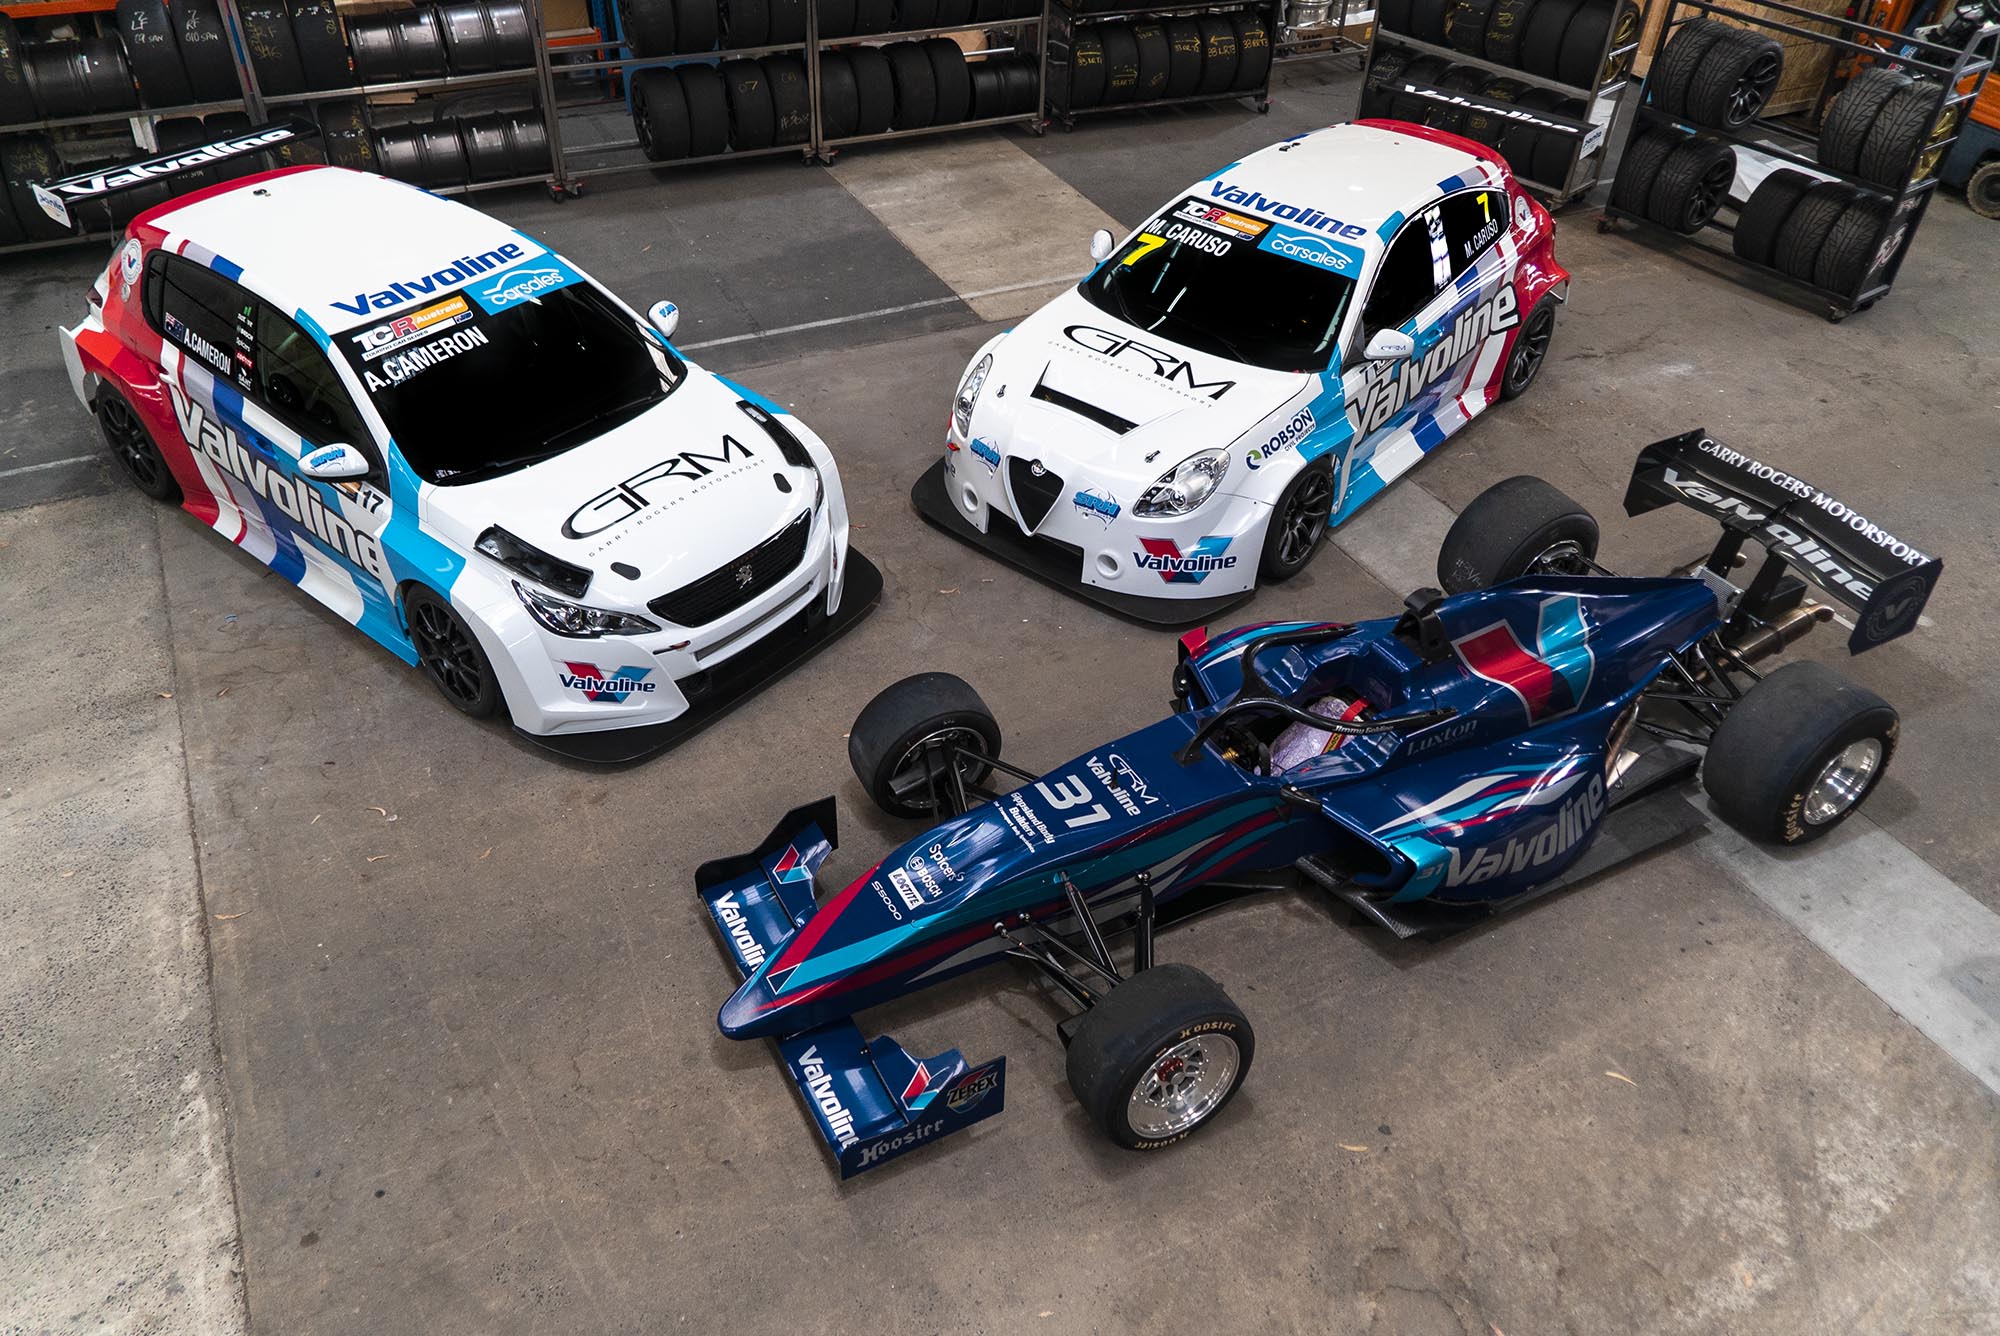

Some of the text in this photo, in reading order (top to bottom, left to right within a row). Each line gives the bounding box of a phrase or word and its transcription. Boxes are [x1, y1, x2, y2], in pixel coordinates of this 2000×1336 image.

[60, 128, 295, 194] Valvoline
[1210, 180, 1368, 241] Valvoline
[1476, 192, 1490, 223] 7
[1123, 232, 1168, 266] 7
[1144, 218, 1232, 257] M. CARUSO
[1270, 237, 1348, 271] carsales
[1473, 218, 1499, 252] CARUSO
[329, 242, 525, 317] Valvoline
[490, 270, 565, 306] carsales
[182, 327, 232, 377] A.CAMERON
[363, 325, 491, 393] A.CAMERON
[1063, 325, 1237, 400] GRM
[1340, 279, 1520, 448] Valvoline
[1260, 409, 1315, 460] ROBSON
[168, 398, 386, 583] Valvoline
[362, 488, 385, 515] 17
[561, 434, 755, 540] GRM
[1698, 438, 1932, 568] GARRY ROGERS MOTORSPORT
[1663, 466, 1874, 602] Valvoline
[1132, 551, 1238, 572] Valvoline
[558, 673, 656, 693] Valvoline
[1008, 806, 1036, 837] Builders
[1034, 774, 1111, 828] 31
[1036, 823, 1056, 845] Body
[1445, 773, 1604, 888] Valvoline
[918, 868, 943, 898] BOSCH
[947, 1071, 998, 1106] ZEREX
